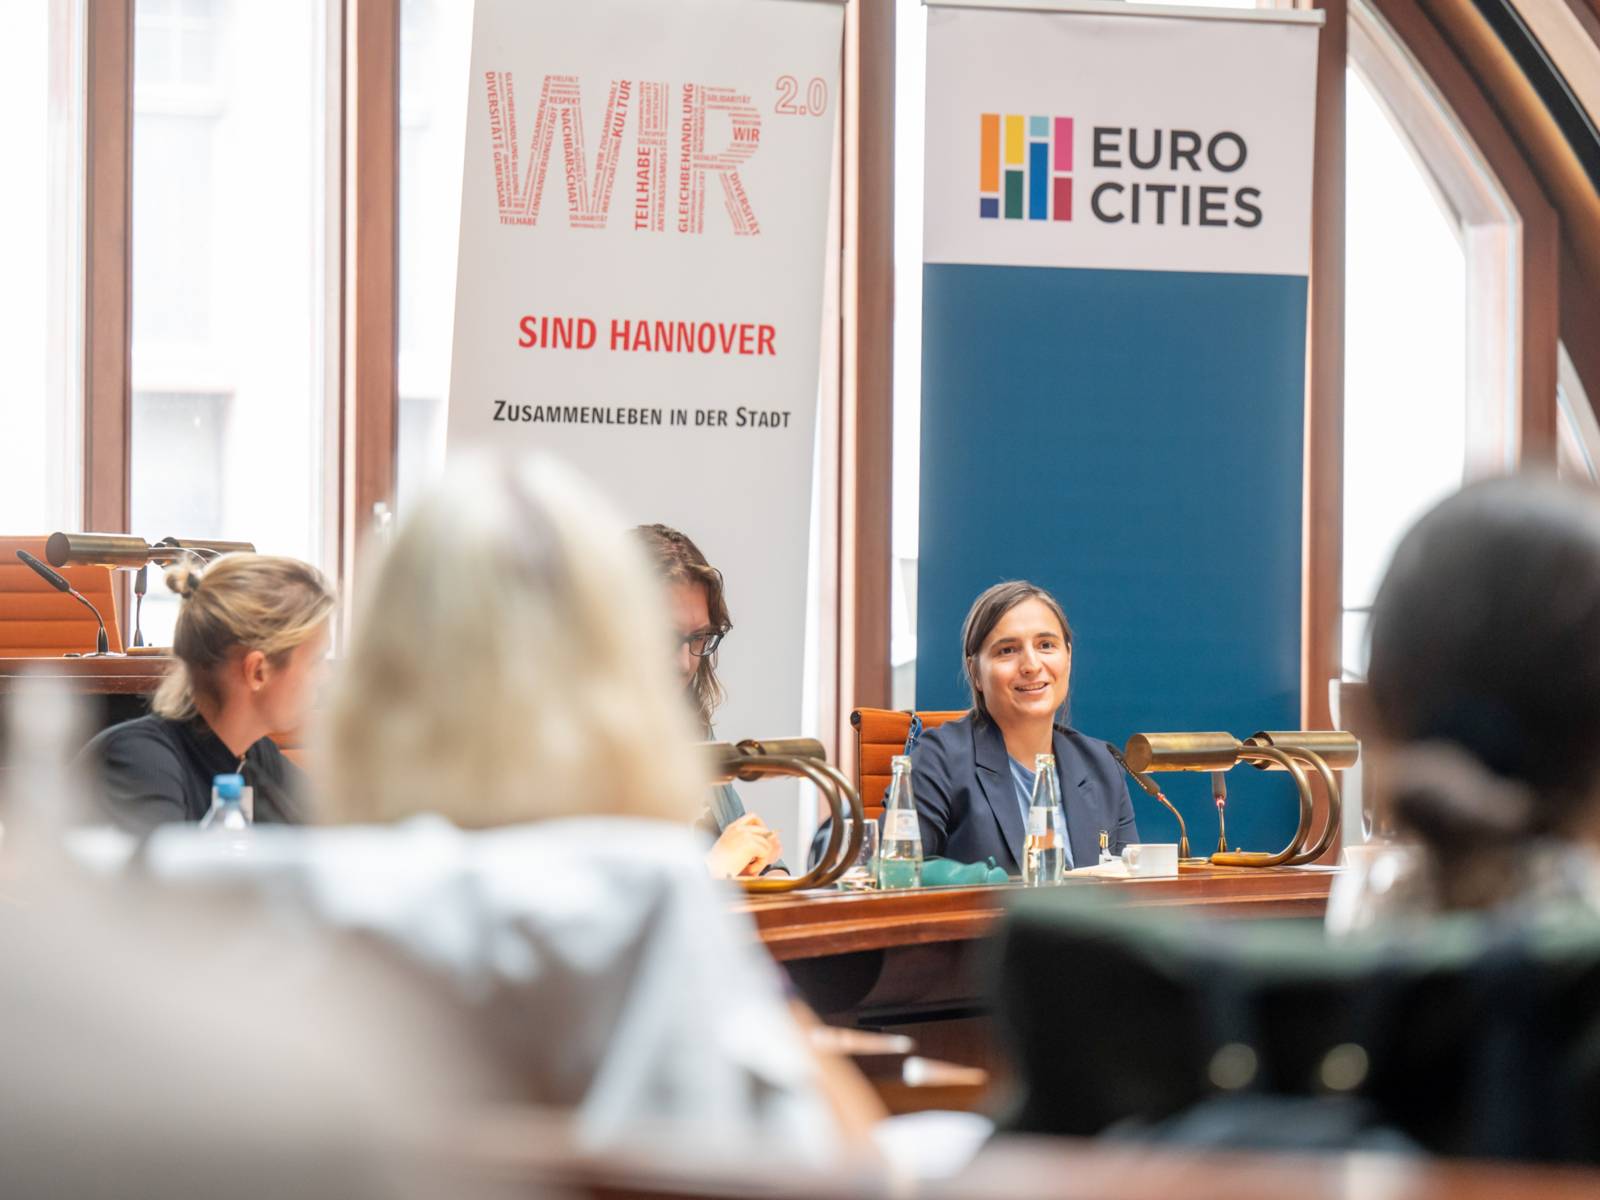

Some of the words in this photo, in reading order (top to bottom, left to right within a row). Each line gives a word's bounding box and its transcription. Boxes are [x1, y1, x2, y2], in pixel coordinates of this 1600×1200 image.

[485, 71, 503, 140] DIVERSITÄT
[549, 95, 581, 105] RESPEKT
[611, 80, 632, 138] KULTUR
[774, 75, 828, 117] 2.0
[560, 107, 579, 211] NACHBARSCHAFT
[678, 83, 694, 232] GLEICHBEHANDLUNG
[732, 127, 760, 142] WIR
[1092, 126, 1248, 173] EURO
[493, 151, 506, 208] GEMEINSAM
[531, 107, 558, 217] EINWANDERUNGSSTADT
[635, 146, 650, 231] TEILHABE
[730, 172, 760, 236] DIVERSITÄT
[1090, 181, 1264, 229] CITIES
[500, 216, 537, 226] TEILHABE
[518, 315, 597, 350] SIND
[610, 319, 777, 356] HANNOVER
[669, 409, 688, 426] IN
[694, 409, 728, 427] DER
[735, 406, 791, 428] STADT
